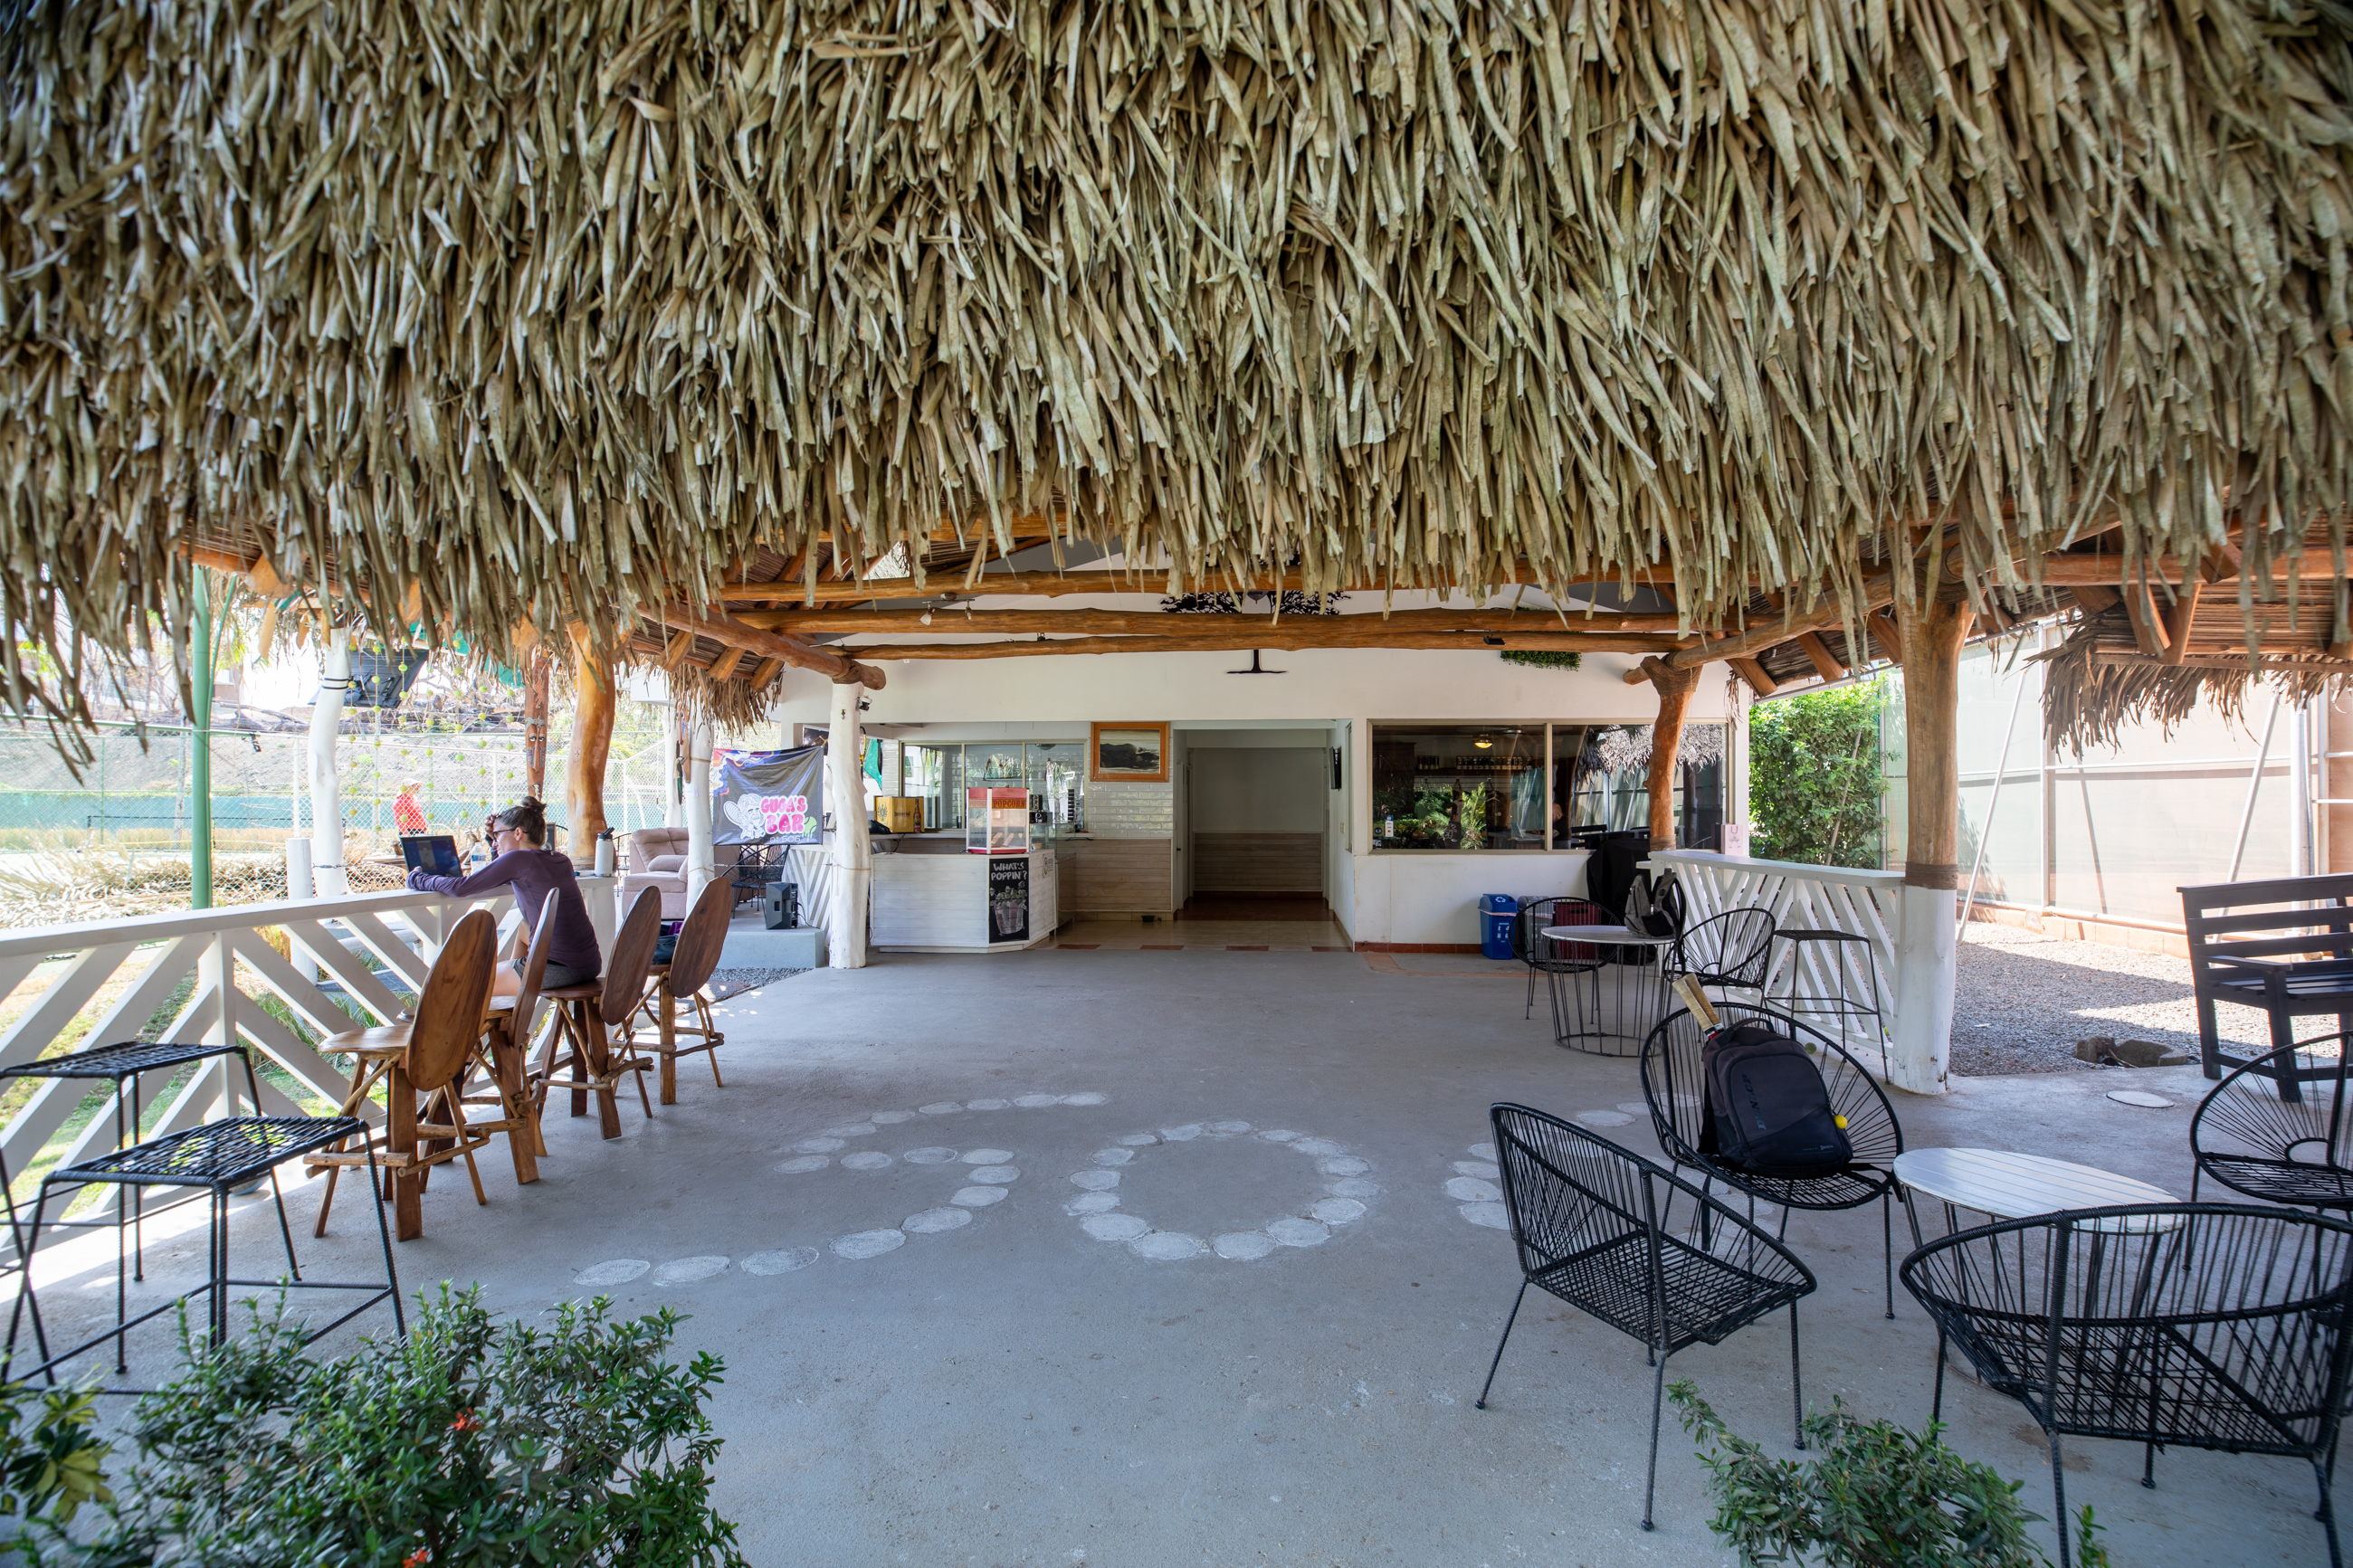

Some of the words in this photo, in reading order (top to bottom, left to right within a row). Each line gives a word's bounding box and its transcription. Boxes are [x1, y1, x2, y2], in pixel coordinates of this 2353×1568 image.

[761, 797, 806, 813] GUGA'S
[767, 813, 804, 832] BAR
[993, 861, 1024, 871] WHAT'S
[1741, 1074, 1767, 1130] DUNLOP
